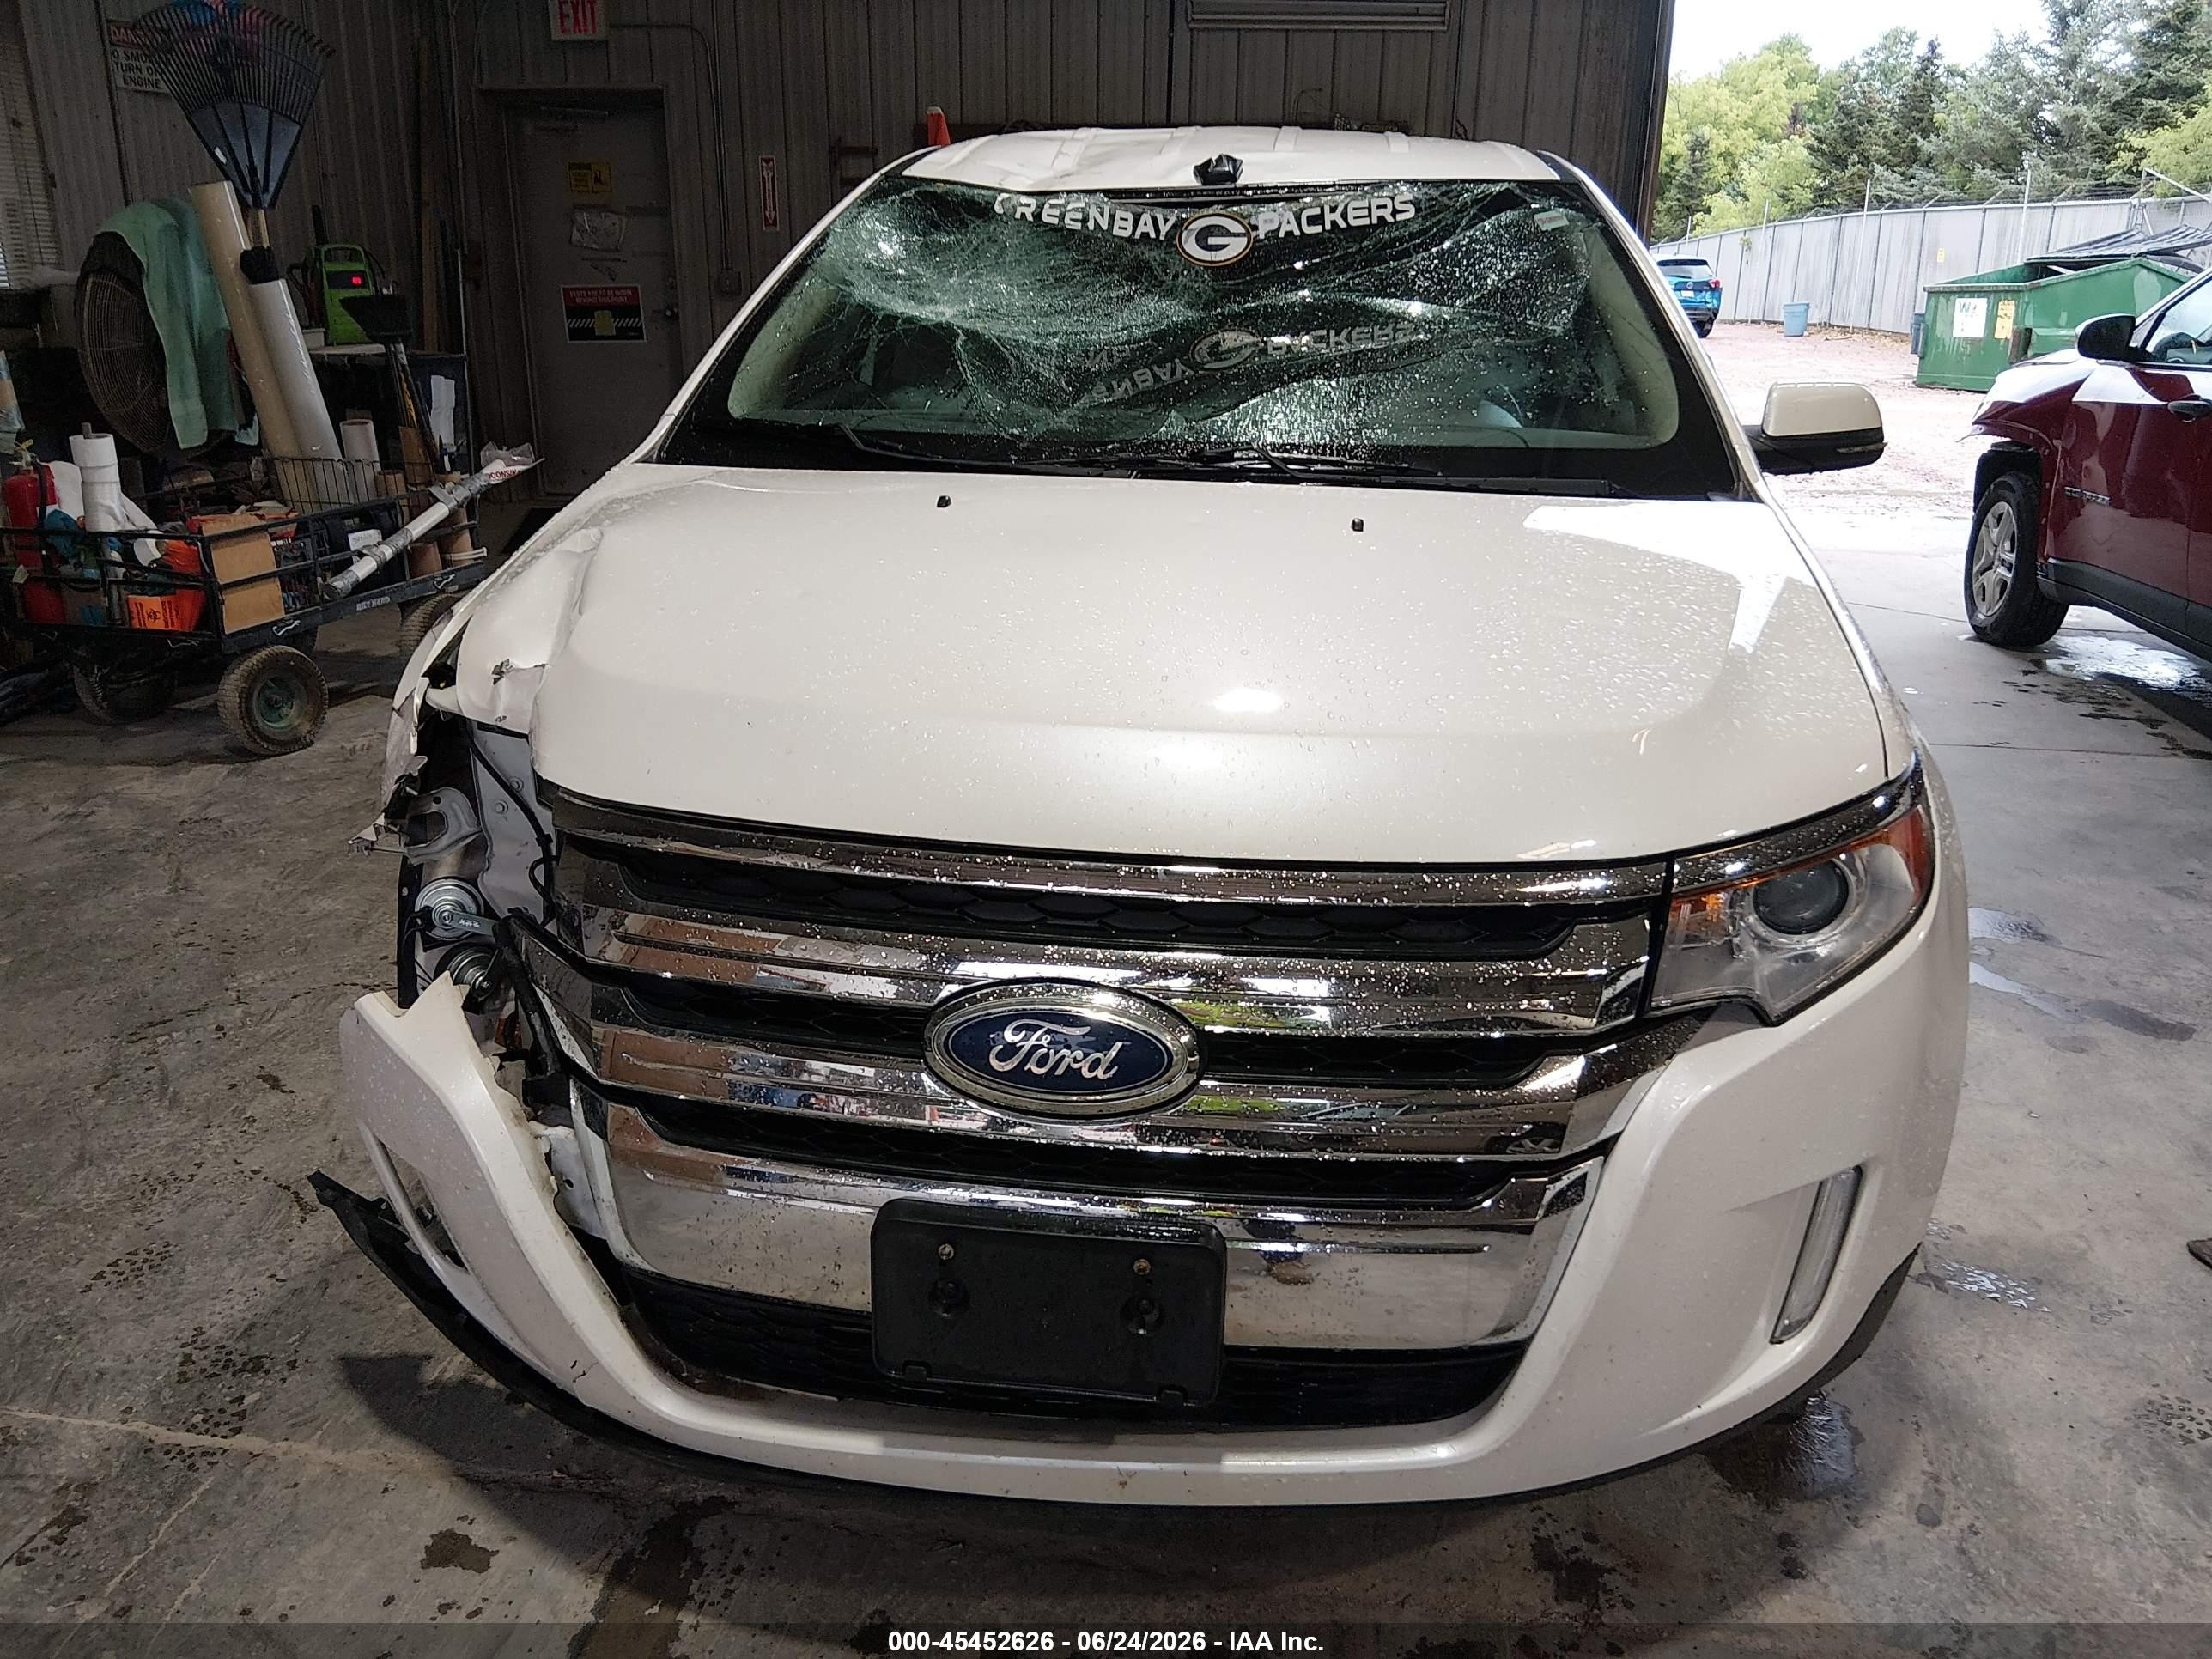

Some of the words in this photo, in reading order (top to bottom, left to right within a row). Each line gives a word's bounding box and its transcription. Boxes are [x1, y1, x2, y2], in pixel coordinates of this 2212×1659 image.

[558, 0, 597, 33] EXIT
[114, 61, 143, 75] TURN
[123, 74, 161, 89] ENGINE
[1257, 193, 1416, 240] PACKERS
[989, 1019, 1123, 1080] Ford
